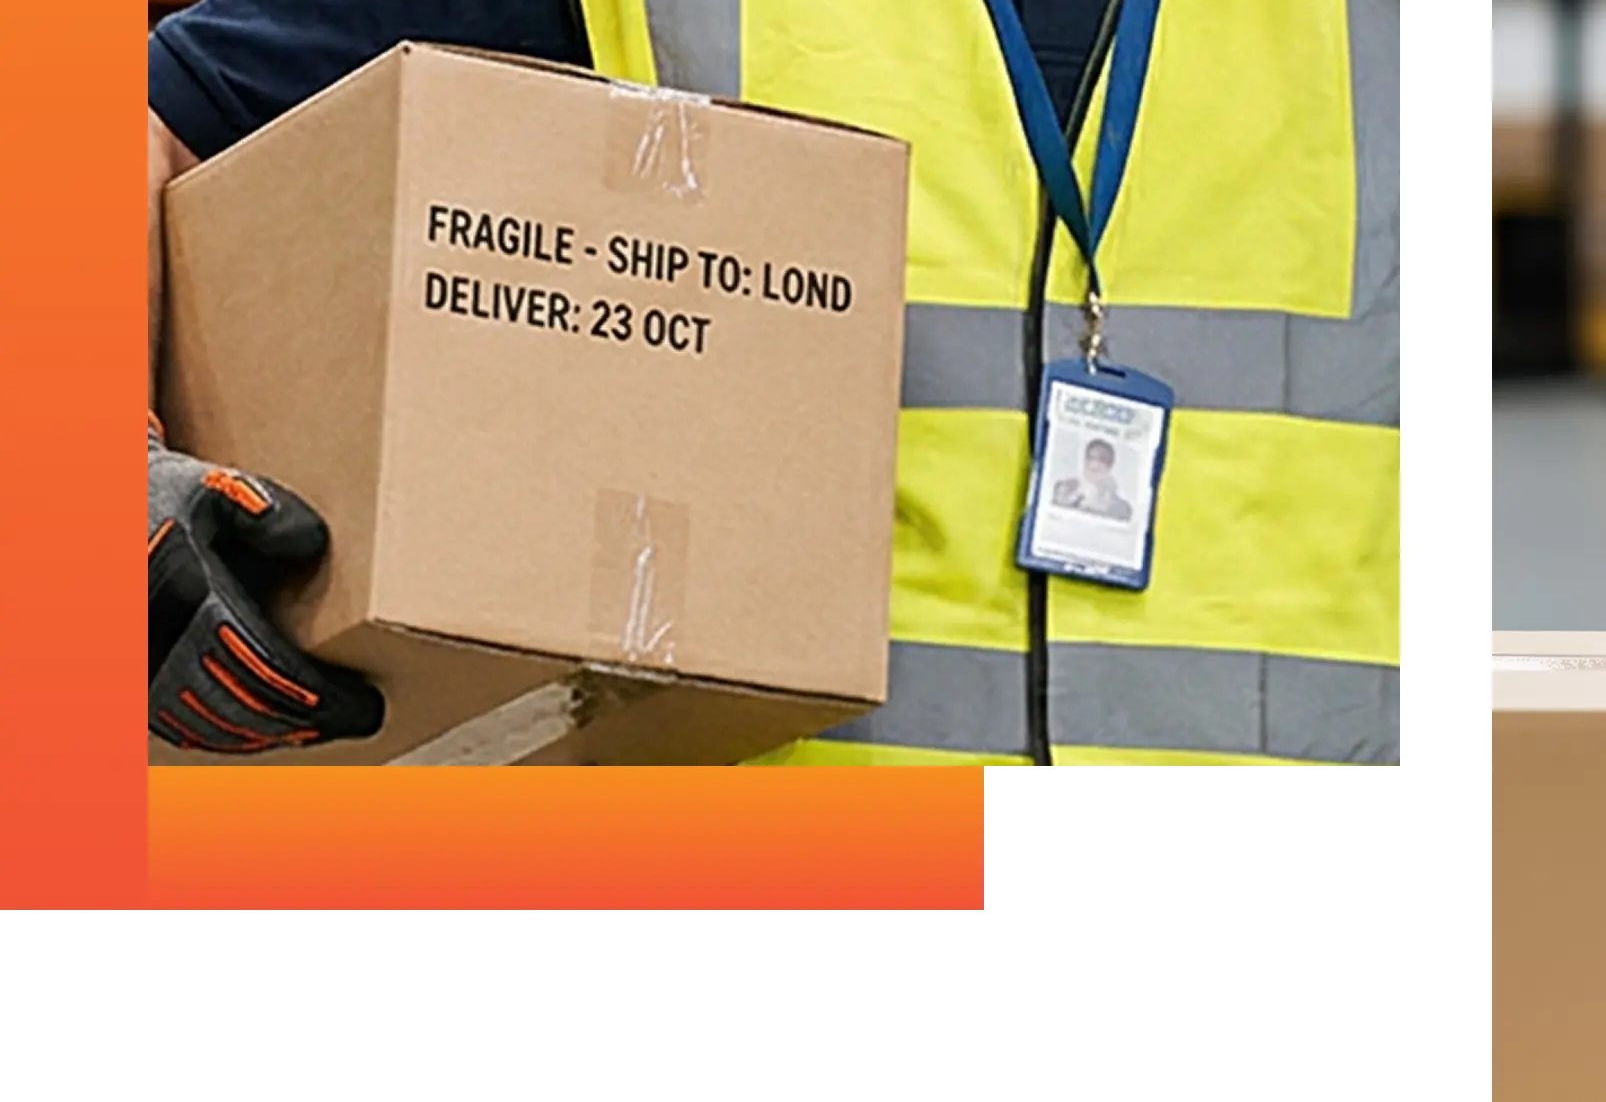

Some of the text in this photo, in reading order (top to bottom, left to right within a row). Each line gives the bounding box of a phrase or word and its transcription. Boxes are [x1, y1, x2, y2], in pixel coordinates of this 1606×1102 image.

[428, 204, 575, 265] FRAGILE
[607, 235, 690, 283] SHIP
[697, 250, 752, 297] TO:
[763, 262, 853, 313] LOND
[425, 272, 712, 354] DELIVER: 23 OCT
